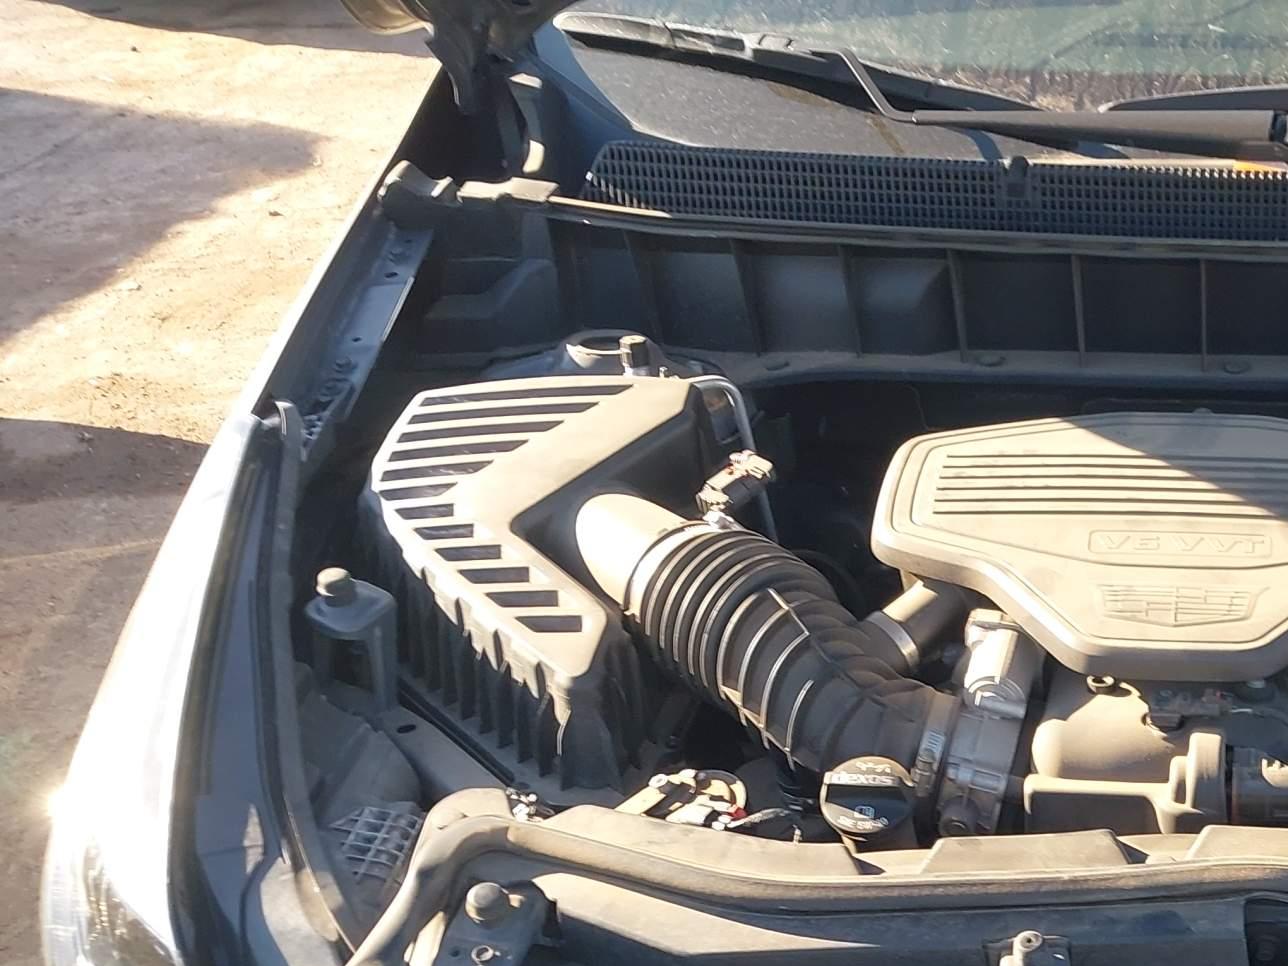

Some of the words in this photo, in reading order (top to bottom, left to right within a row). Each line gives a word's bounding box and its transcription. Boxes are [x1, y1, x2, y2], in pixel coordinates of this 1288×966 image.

[1098, 535, 1161, 551] V6
[1171, 536, 1265, 554] VVT
[831, 771, 895, 785] dexos
